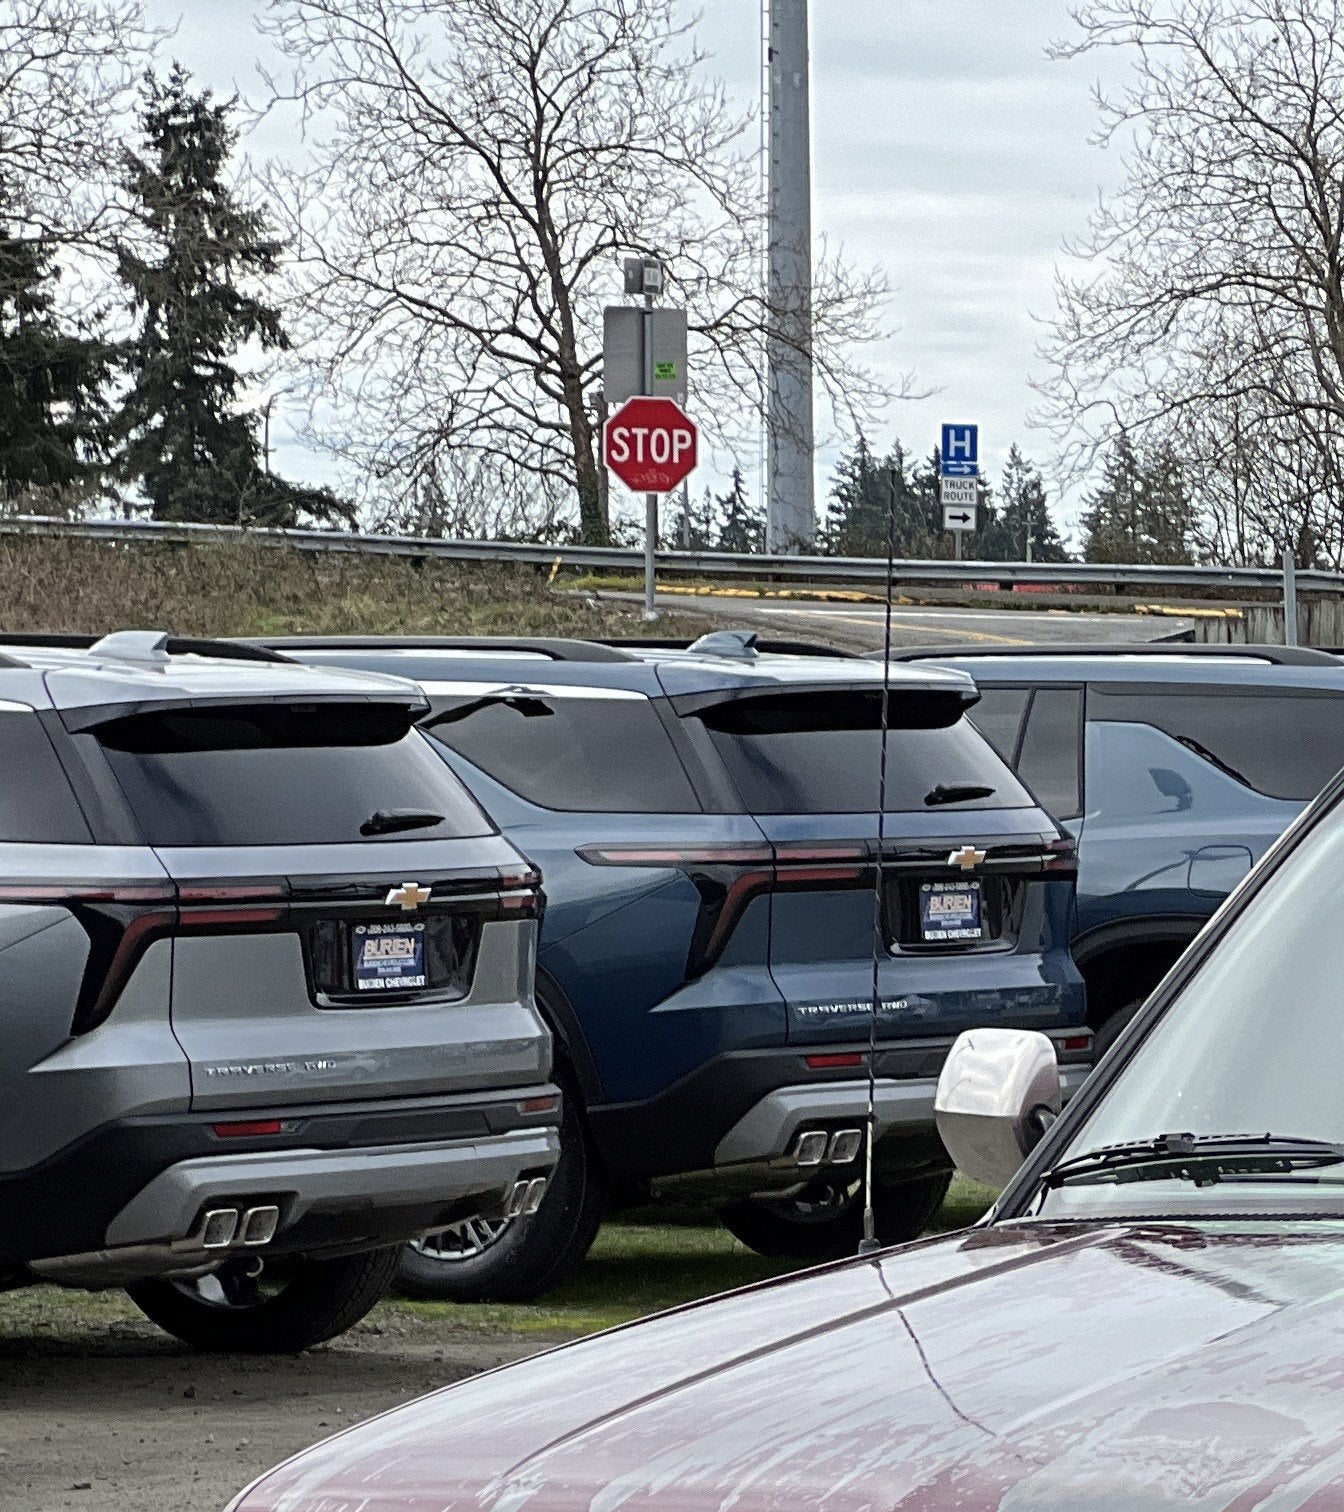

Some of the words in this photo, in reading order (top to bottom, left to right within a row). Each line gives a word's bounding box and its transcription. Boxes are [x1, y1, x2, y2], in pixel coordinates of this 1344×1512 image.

[611, 427, 692, 463] STOP
[948, 428, 971, 458] H
[944, 480, 975, 490] TRUCK
[943, 491, 974, 501] ROUTE
